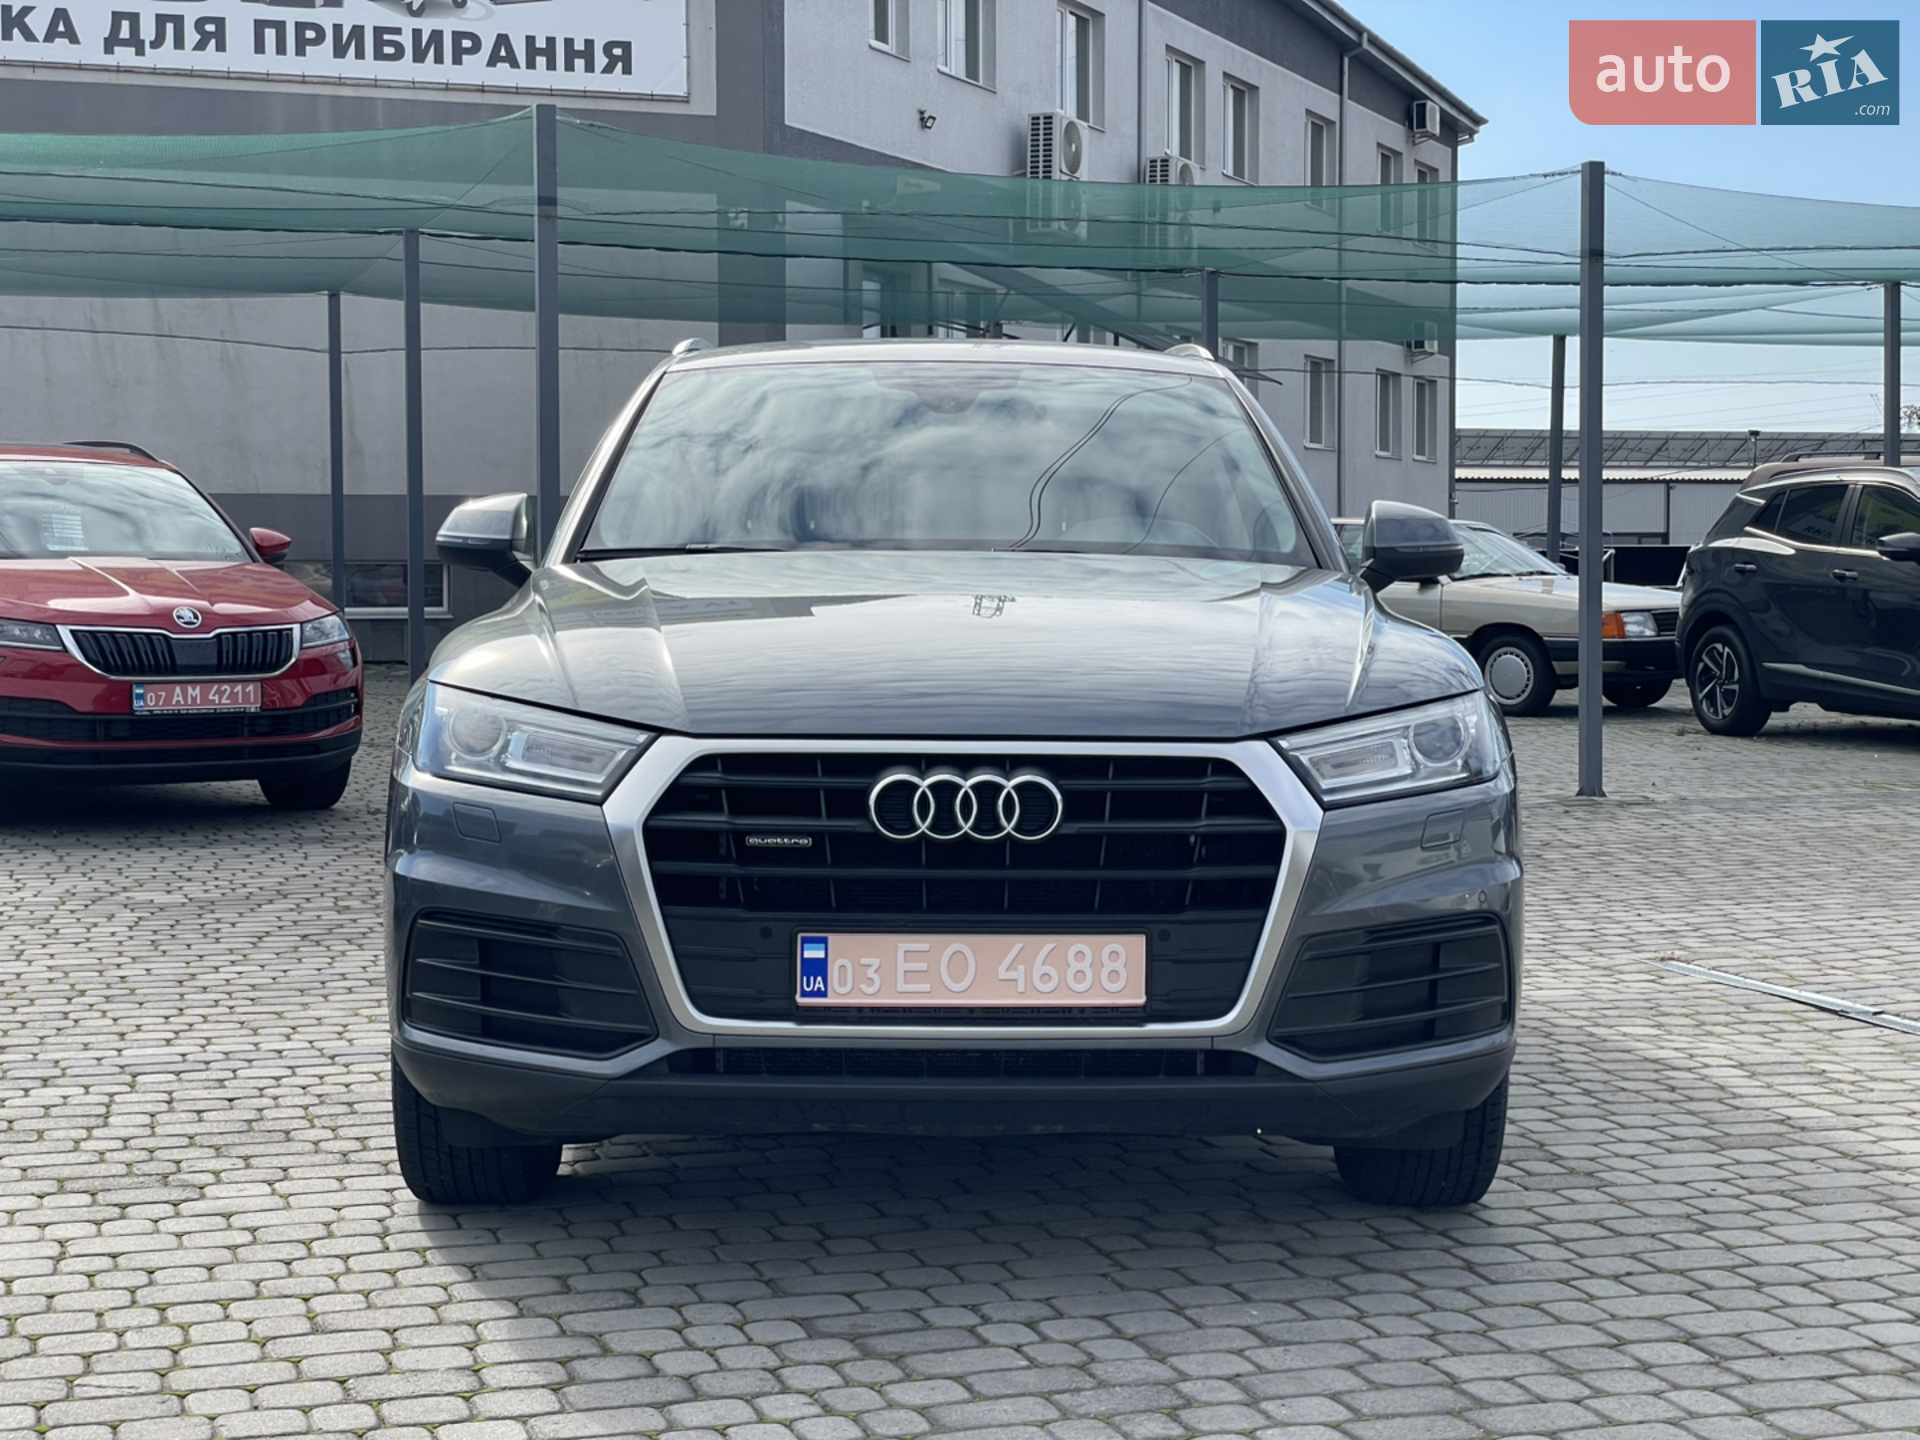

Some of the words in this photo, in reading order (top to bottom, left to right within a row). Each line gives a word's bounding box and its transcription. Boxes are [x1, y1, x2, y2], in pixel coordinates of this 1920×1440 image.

[103, 10, 227, 56] ДЛЯ
[253, 18, 633, 76] ПРИБИРАННЯ
[147, 692, 166, 706] 07
[172, 685, 200, 705] AM
[208, 684, 255, 704] 4211
[803, 976, 825, 992] UA
[832, 958, 881, 995] 03
[897, 943, 976, 993] EO
[997, 943, 1128, 993] 4688
